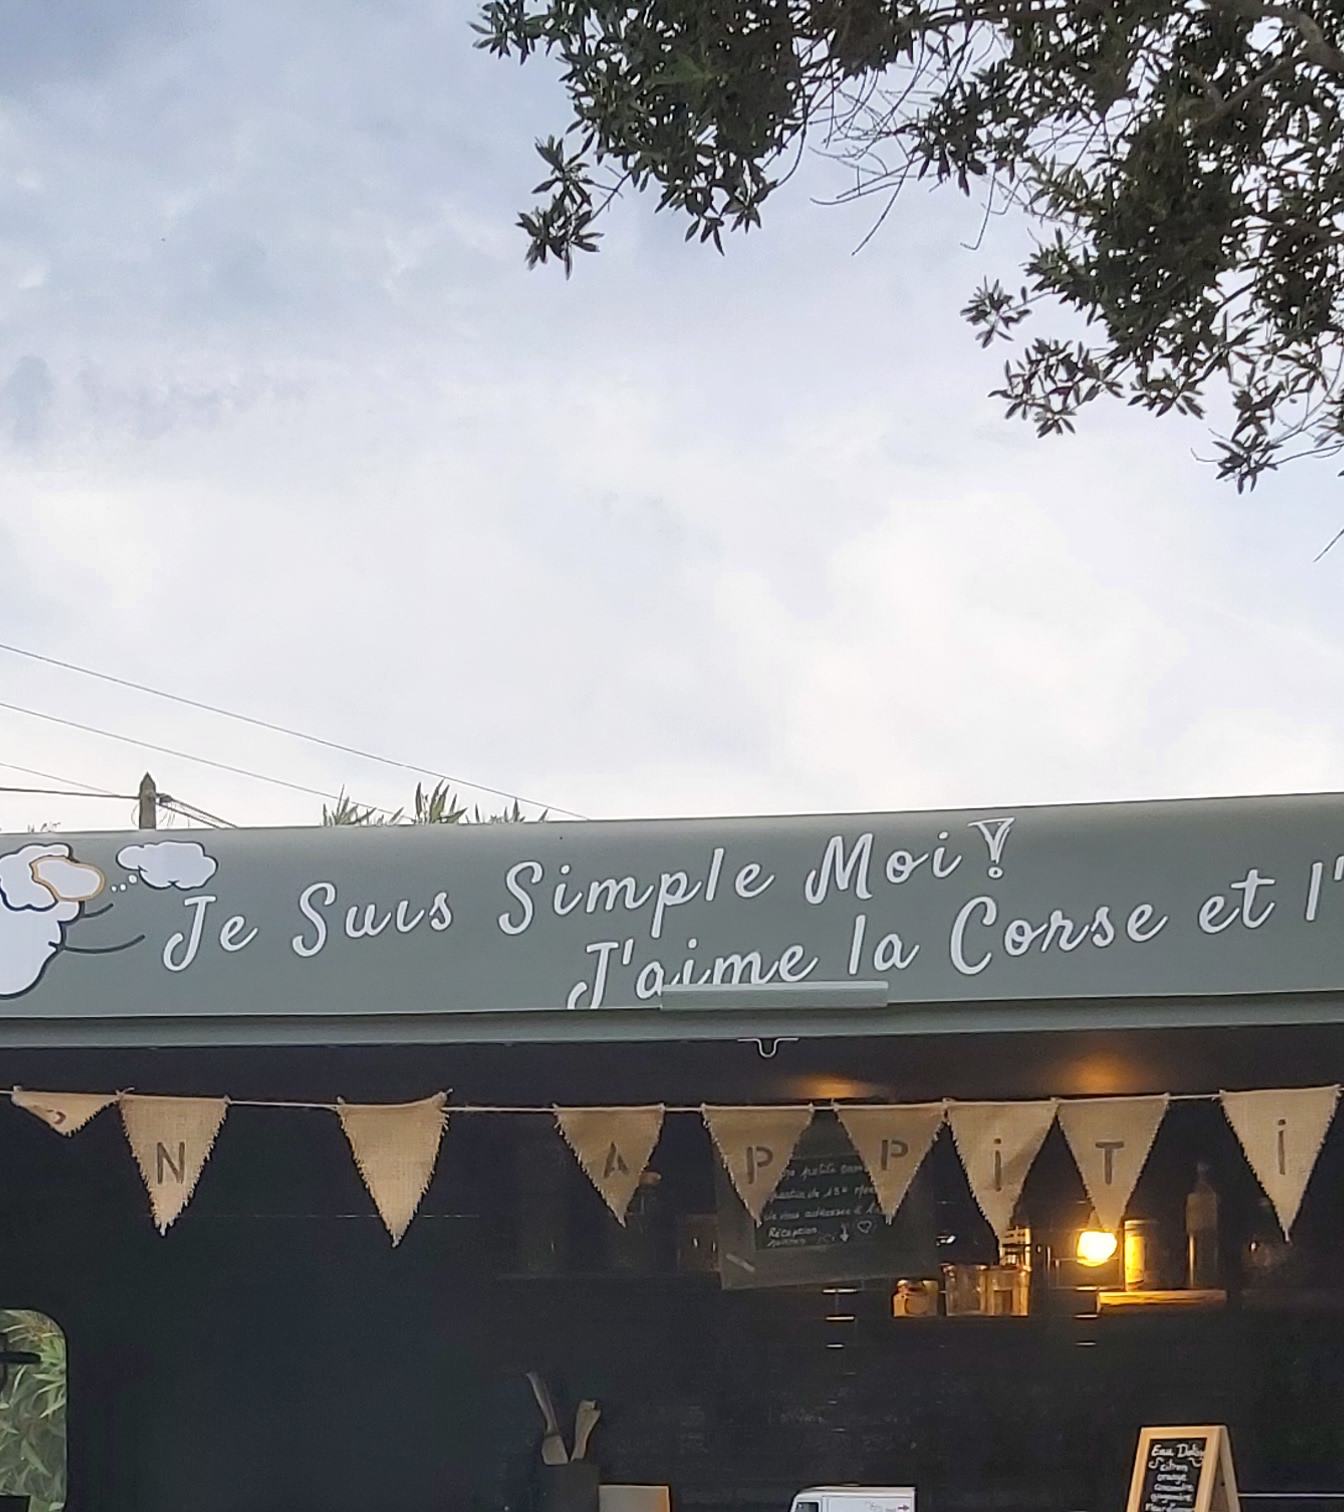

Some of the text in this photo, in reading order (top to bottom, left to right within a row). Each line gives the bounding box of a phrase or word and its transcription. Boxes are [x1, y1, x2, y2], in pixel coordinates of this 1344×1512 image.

[162, 894, 258, 971] Je
[291, 881, 453, 958] Suis
[499, 847, 774, 938] Simple
[568, 937, 818, 1008] J'aime
[848, 914, 919, 975] la
[950, 896, 1167, 975] Corse
[1198, 868, 1275, 934] et
